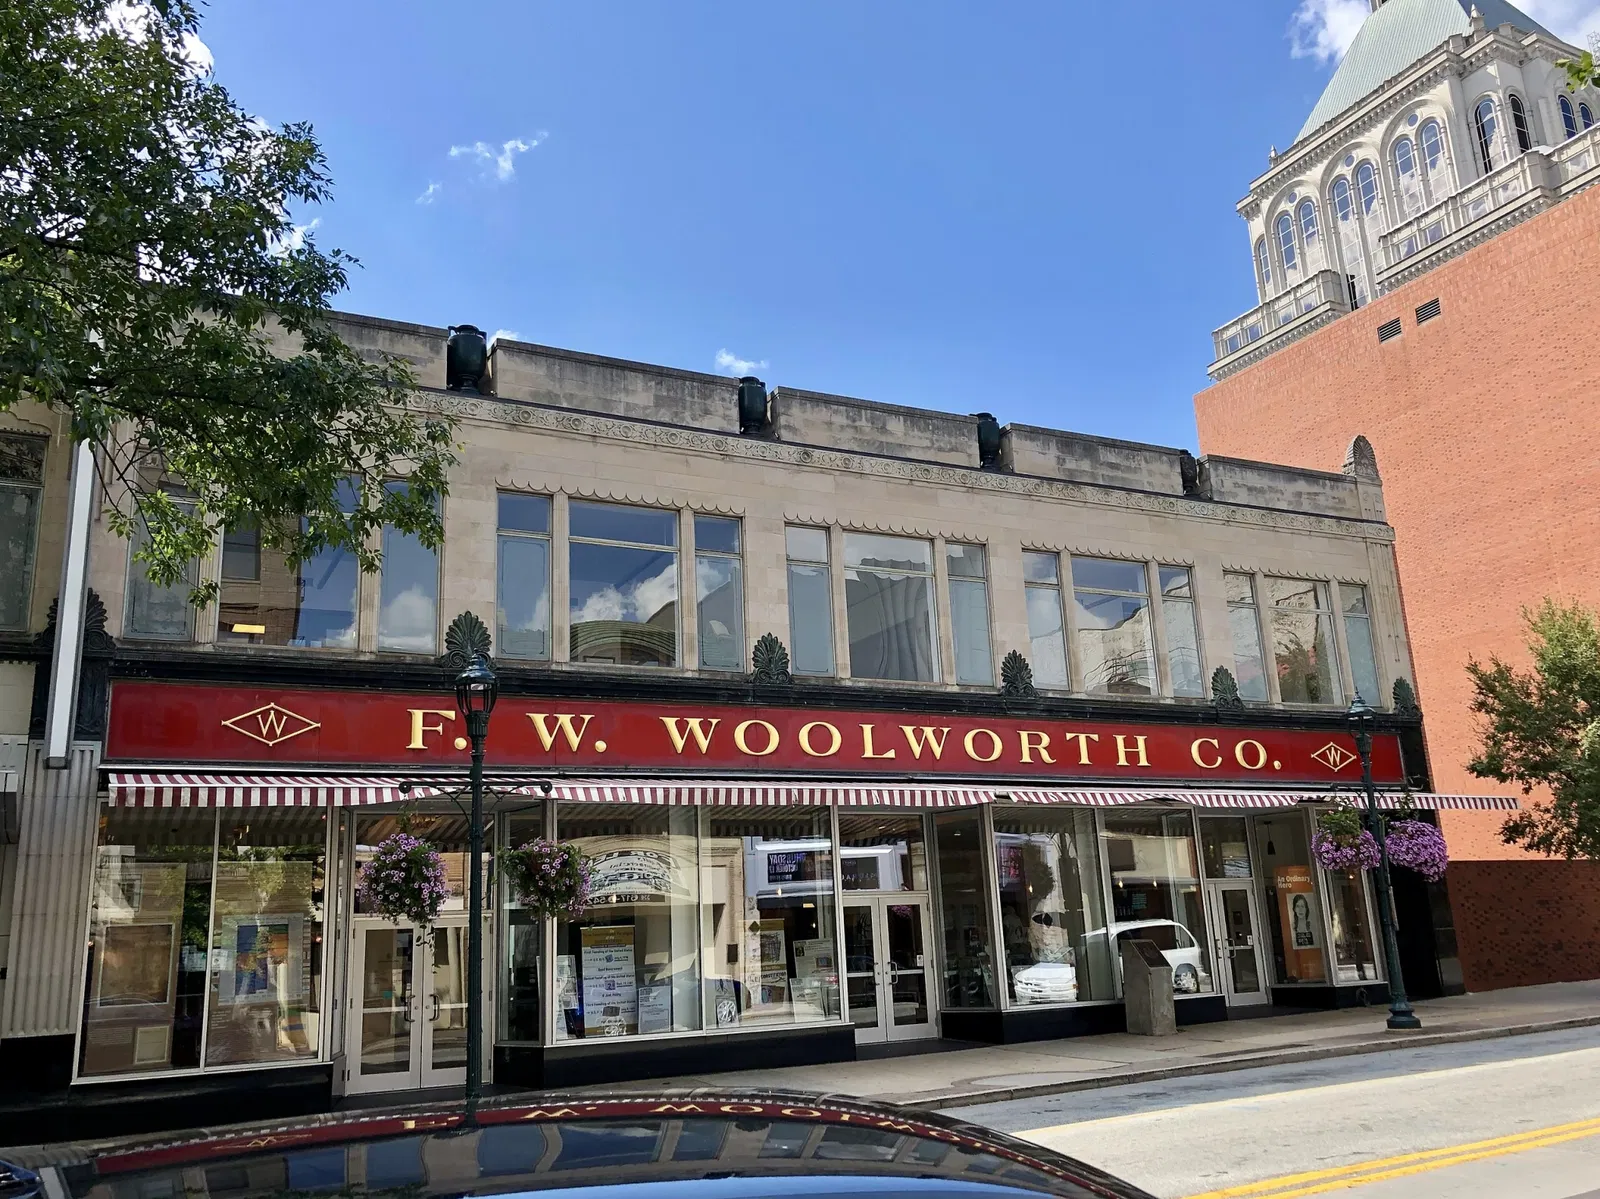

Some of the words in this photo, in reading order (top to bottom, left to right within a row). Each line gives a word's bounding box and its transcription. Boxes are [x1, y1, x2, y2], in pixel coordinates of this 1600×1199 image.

[256, 709, 289, 738] W
[405, 708, 468, 750] F.
[525, 712, 608, 753] W.
[659, 715, 1152, 767] WOOLWORTH
[1190, 737, 1282, 770] CO.
